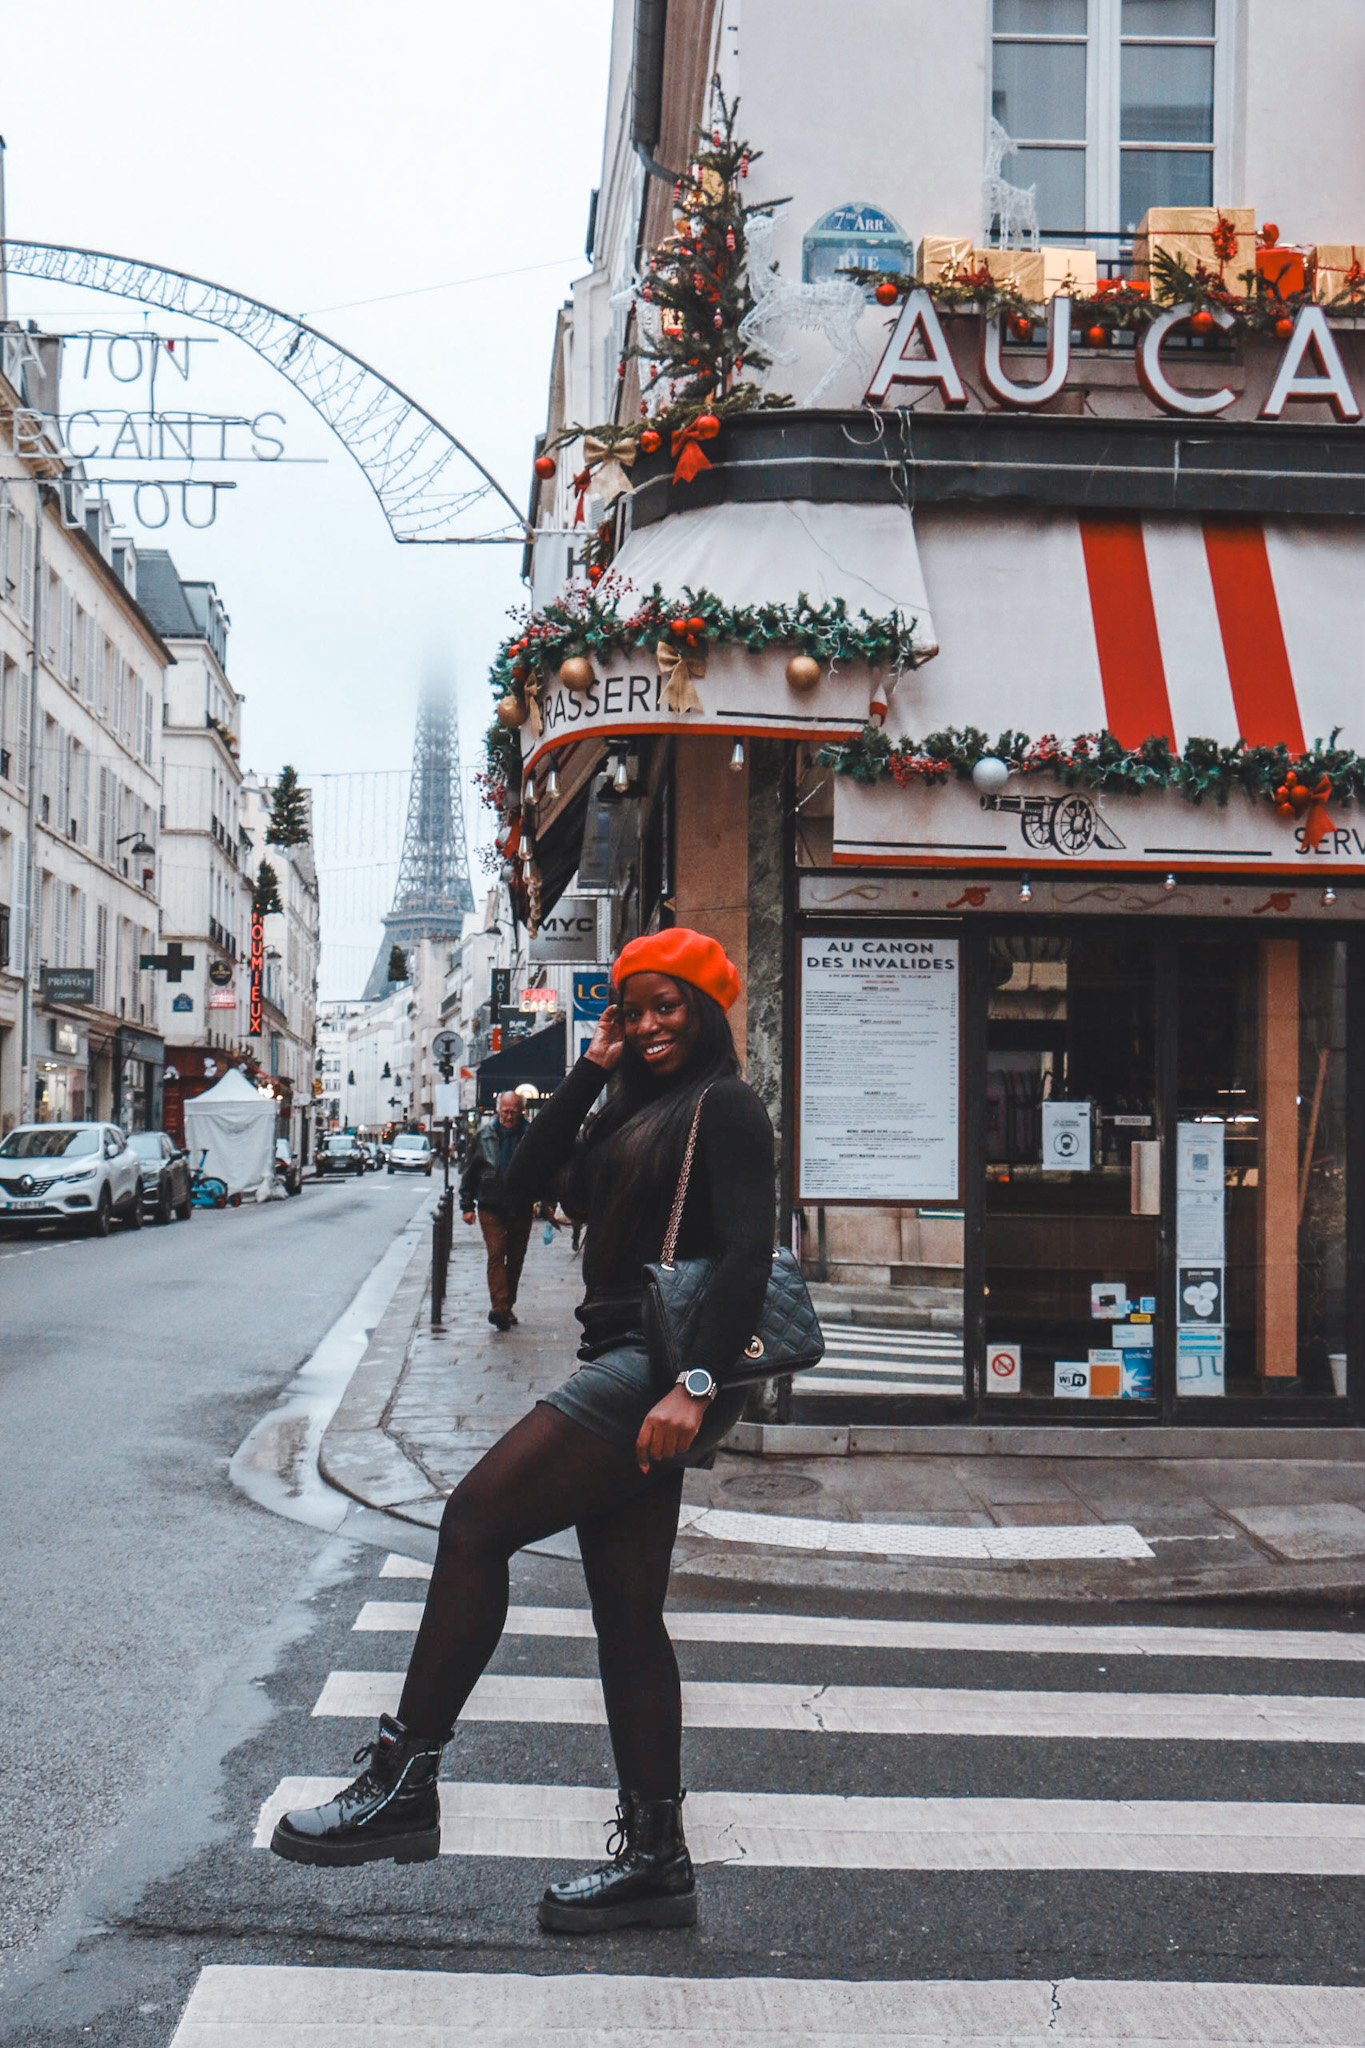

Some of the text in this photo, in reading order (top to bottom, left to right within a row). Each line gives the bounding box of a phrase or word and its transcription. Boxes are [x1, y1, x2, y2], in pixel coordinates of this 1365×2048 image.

[865, 288, 1071, 412] AU
[827, 942, 934, 954] AU CANON
[807, 957, 955, 970] DES INVALIDES
